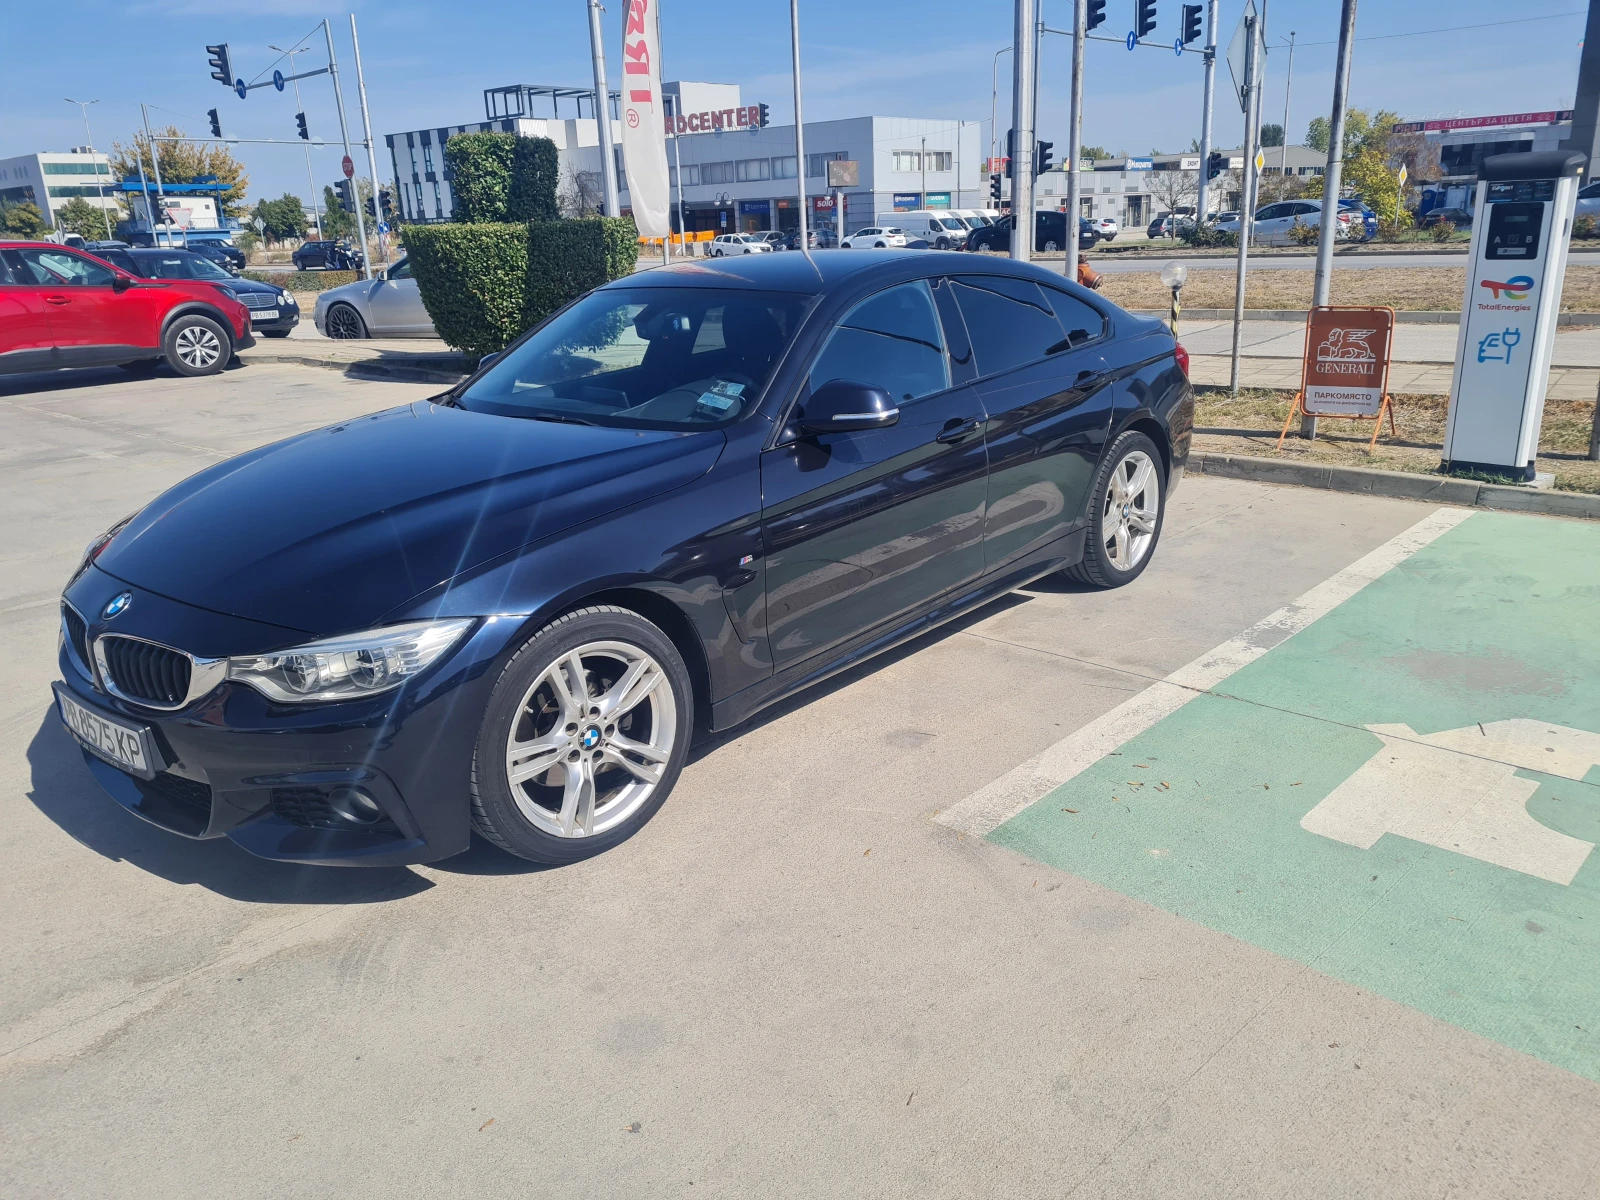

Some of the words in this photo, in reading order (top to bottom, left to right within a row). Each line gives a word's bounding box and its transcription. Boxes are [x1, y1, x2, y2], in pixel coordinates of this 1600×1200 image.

[1445, 119, 1483, 128] ЦЕНТЪР
[1501, 114, 1532, 124] ЦВЕТЯ
[1477, 303, 1531, 312] TotalEnergies
[1315, 362, 1375, 374] GENERALI
[1314, 391, 1372, 400] ПАРКОМЯСТО
[79, 708, 115, 755] 8575
[114, 728, 140, 765] KP
